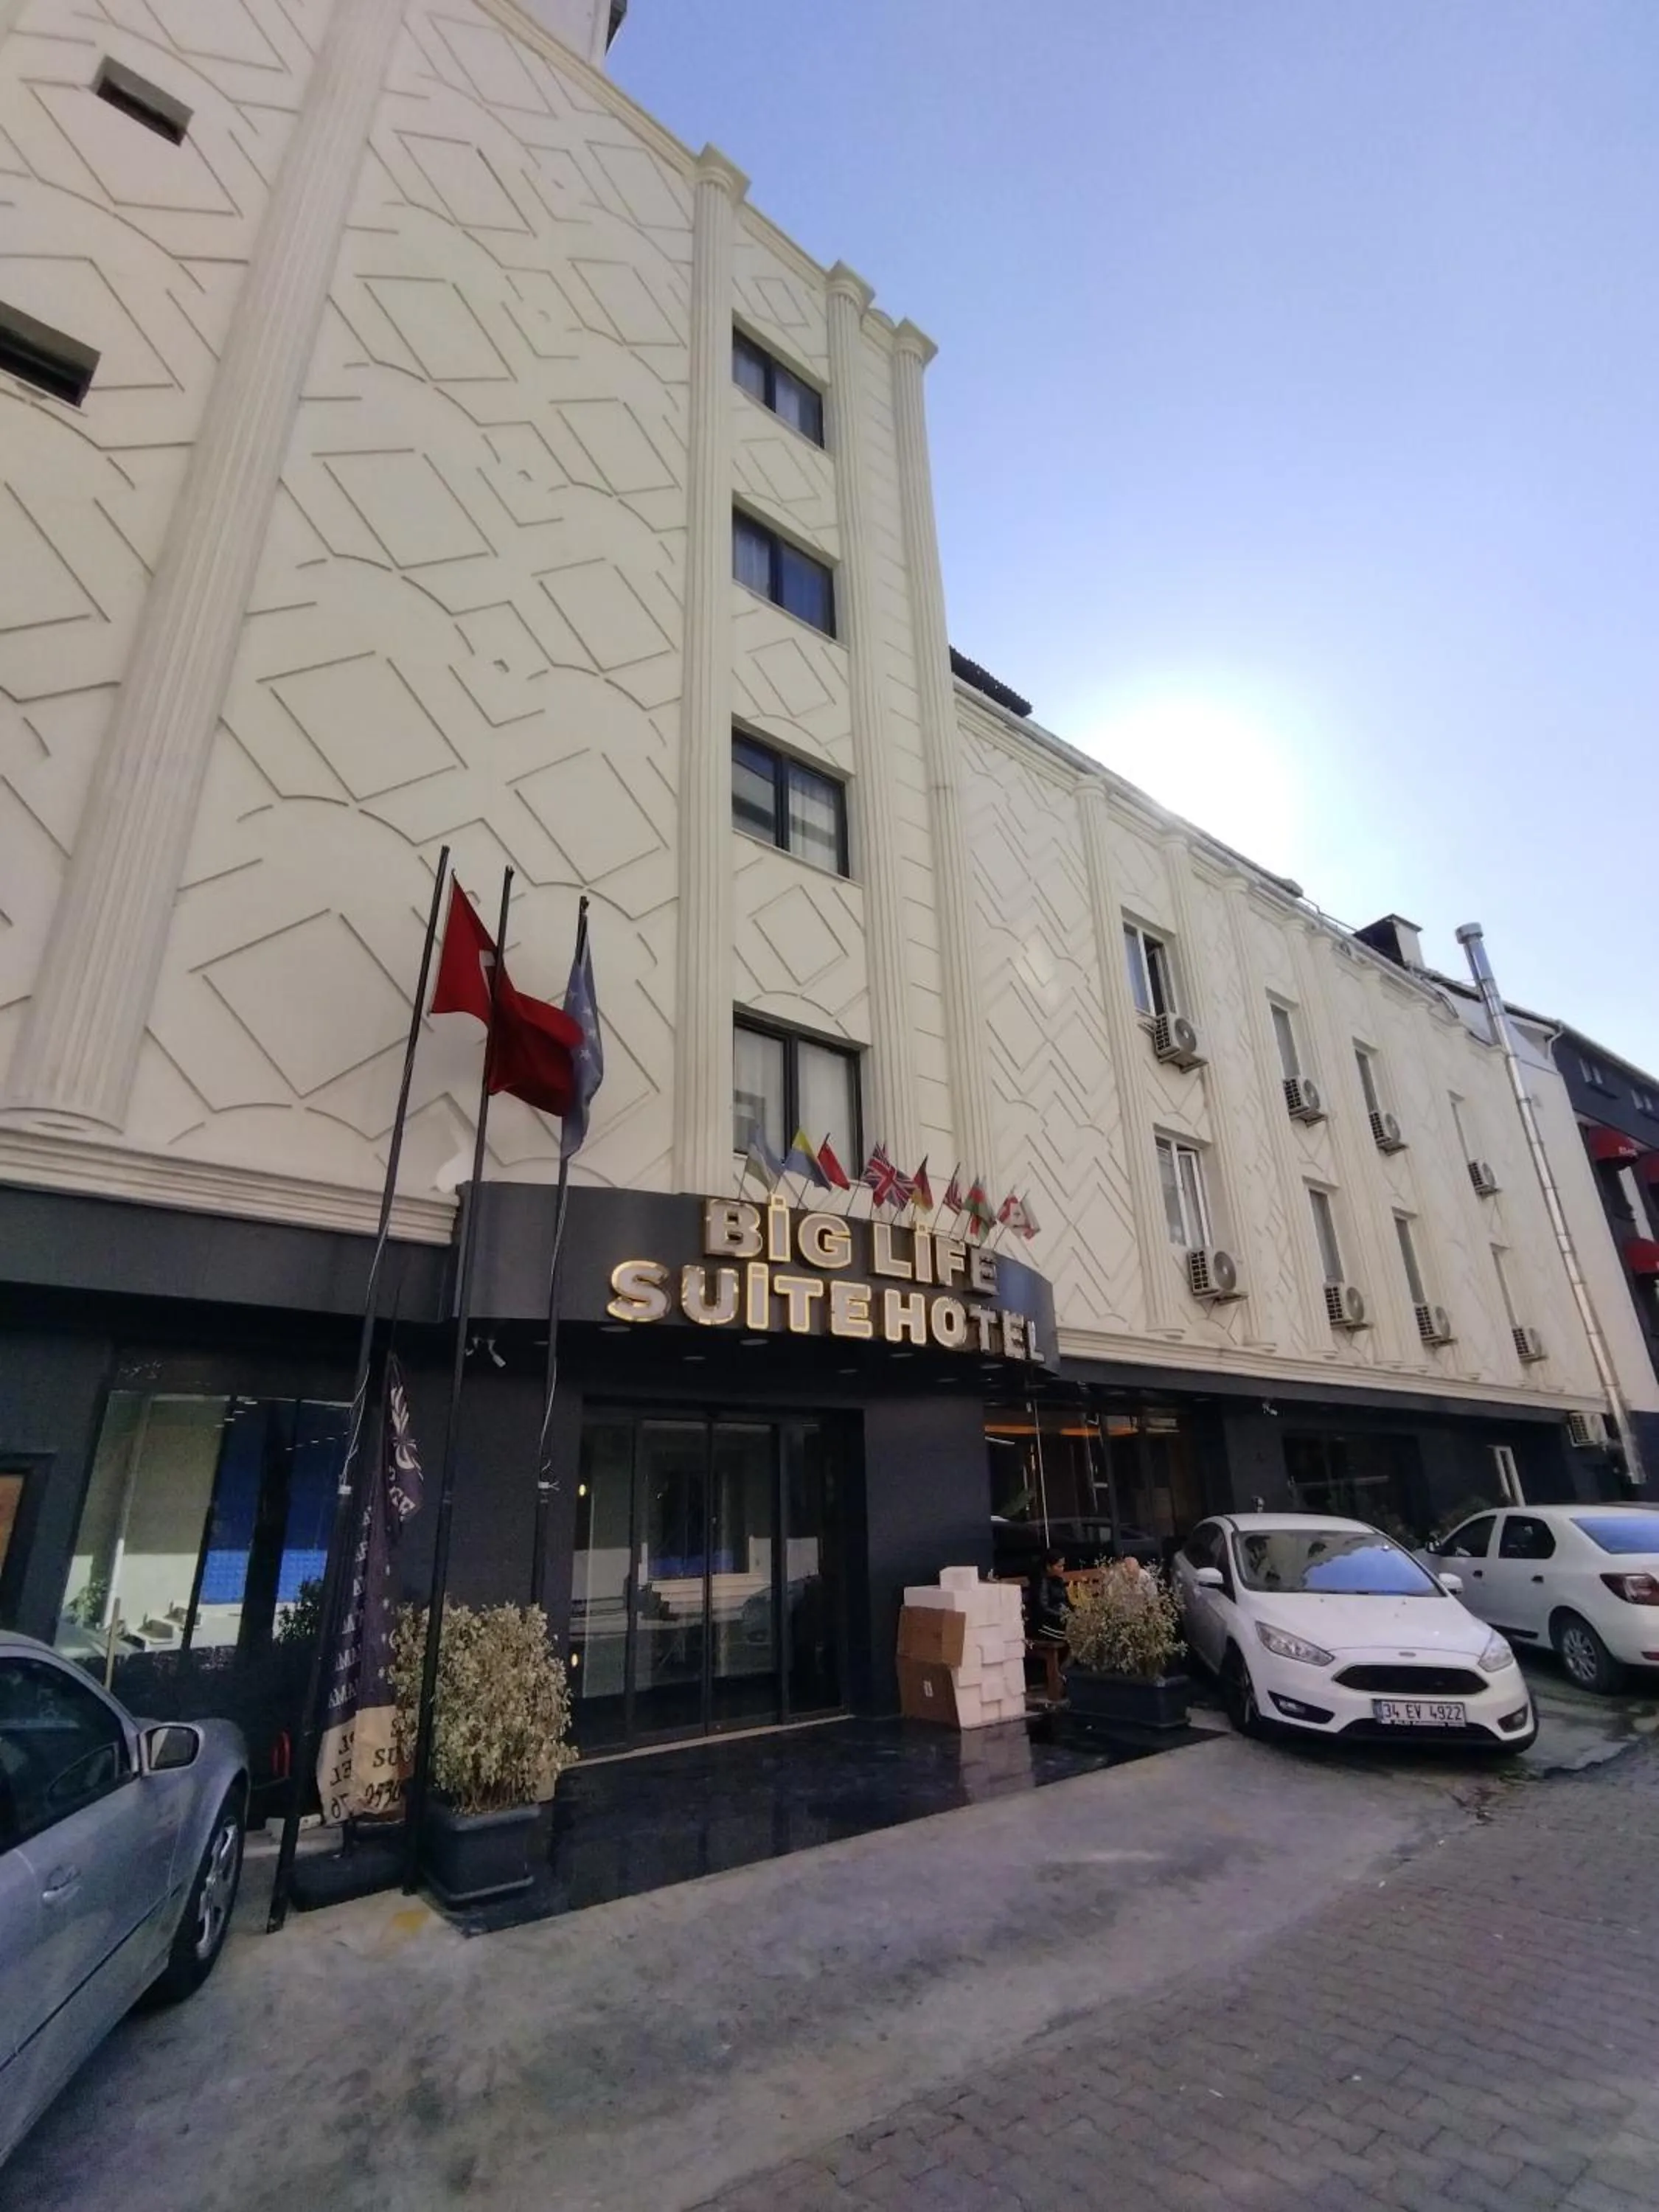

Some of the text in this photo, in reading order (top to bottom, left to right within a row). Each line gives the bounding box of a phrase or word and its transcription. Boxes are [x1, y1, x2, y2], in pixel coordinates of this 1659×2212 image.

[1382, 1703, 1463, 1721] 34 EV 4922
